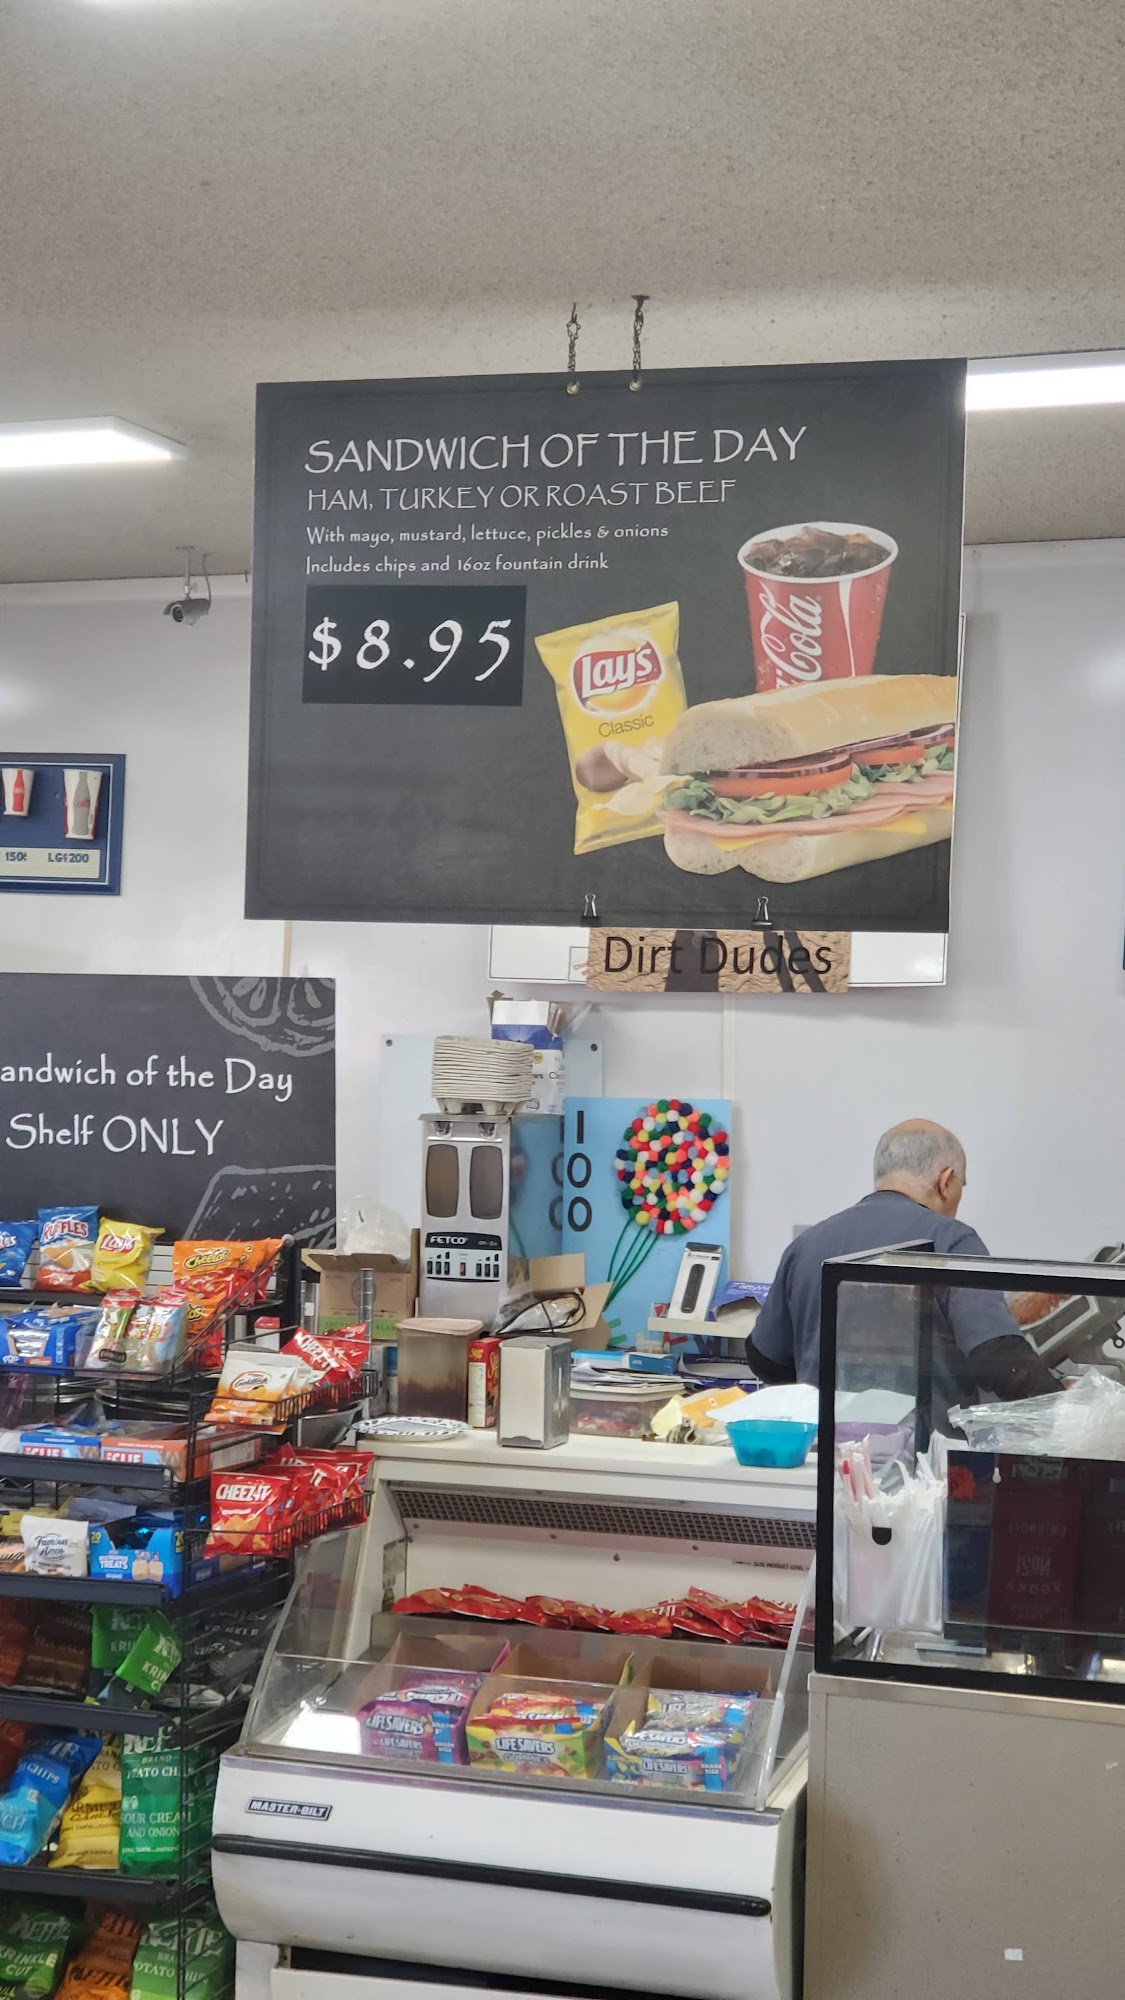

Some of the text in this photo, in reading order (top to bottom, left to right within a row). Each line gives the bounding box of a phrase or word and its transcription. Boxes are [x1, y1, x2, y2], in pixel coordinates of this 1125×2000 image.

[304, 426, 807, 474] SANDWICH OF THE DAY
[307, 479, 737, 511] HAM, TURKEY OR ROAST BEEF
[306, 522, 669, 548] With mayo, mustard, lettuce, pickles & onions
[306, 552, 609, 579] Includes chips and 16oz fountain drink
[307, 616, 512, 682] $8.95
[581, 645, 653, 699] Lay's
[598, 713, 654, 738] Classic
[604, 934, 832, 975] Dirt Dudes
[126, 1055, 159, 1086] of
[166, 1055, 215, 1087] the
[224, 1057, 293, 1103] Day
[5, 1112, 224, 1156] Shelf ONLY
[430, 1235, 467, 1246] FETCO
[26, 1761, 60, 1785] CHIPS
